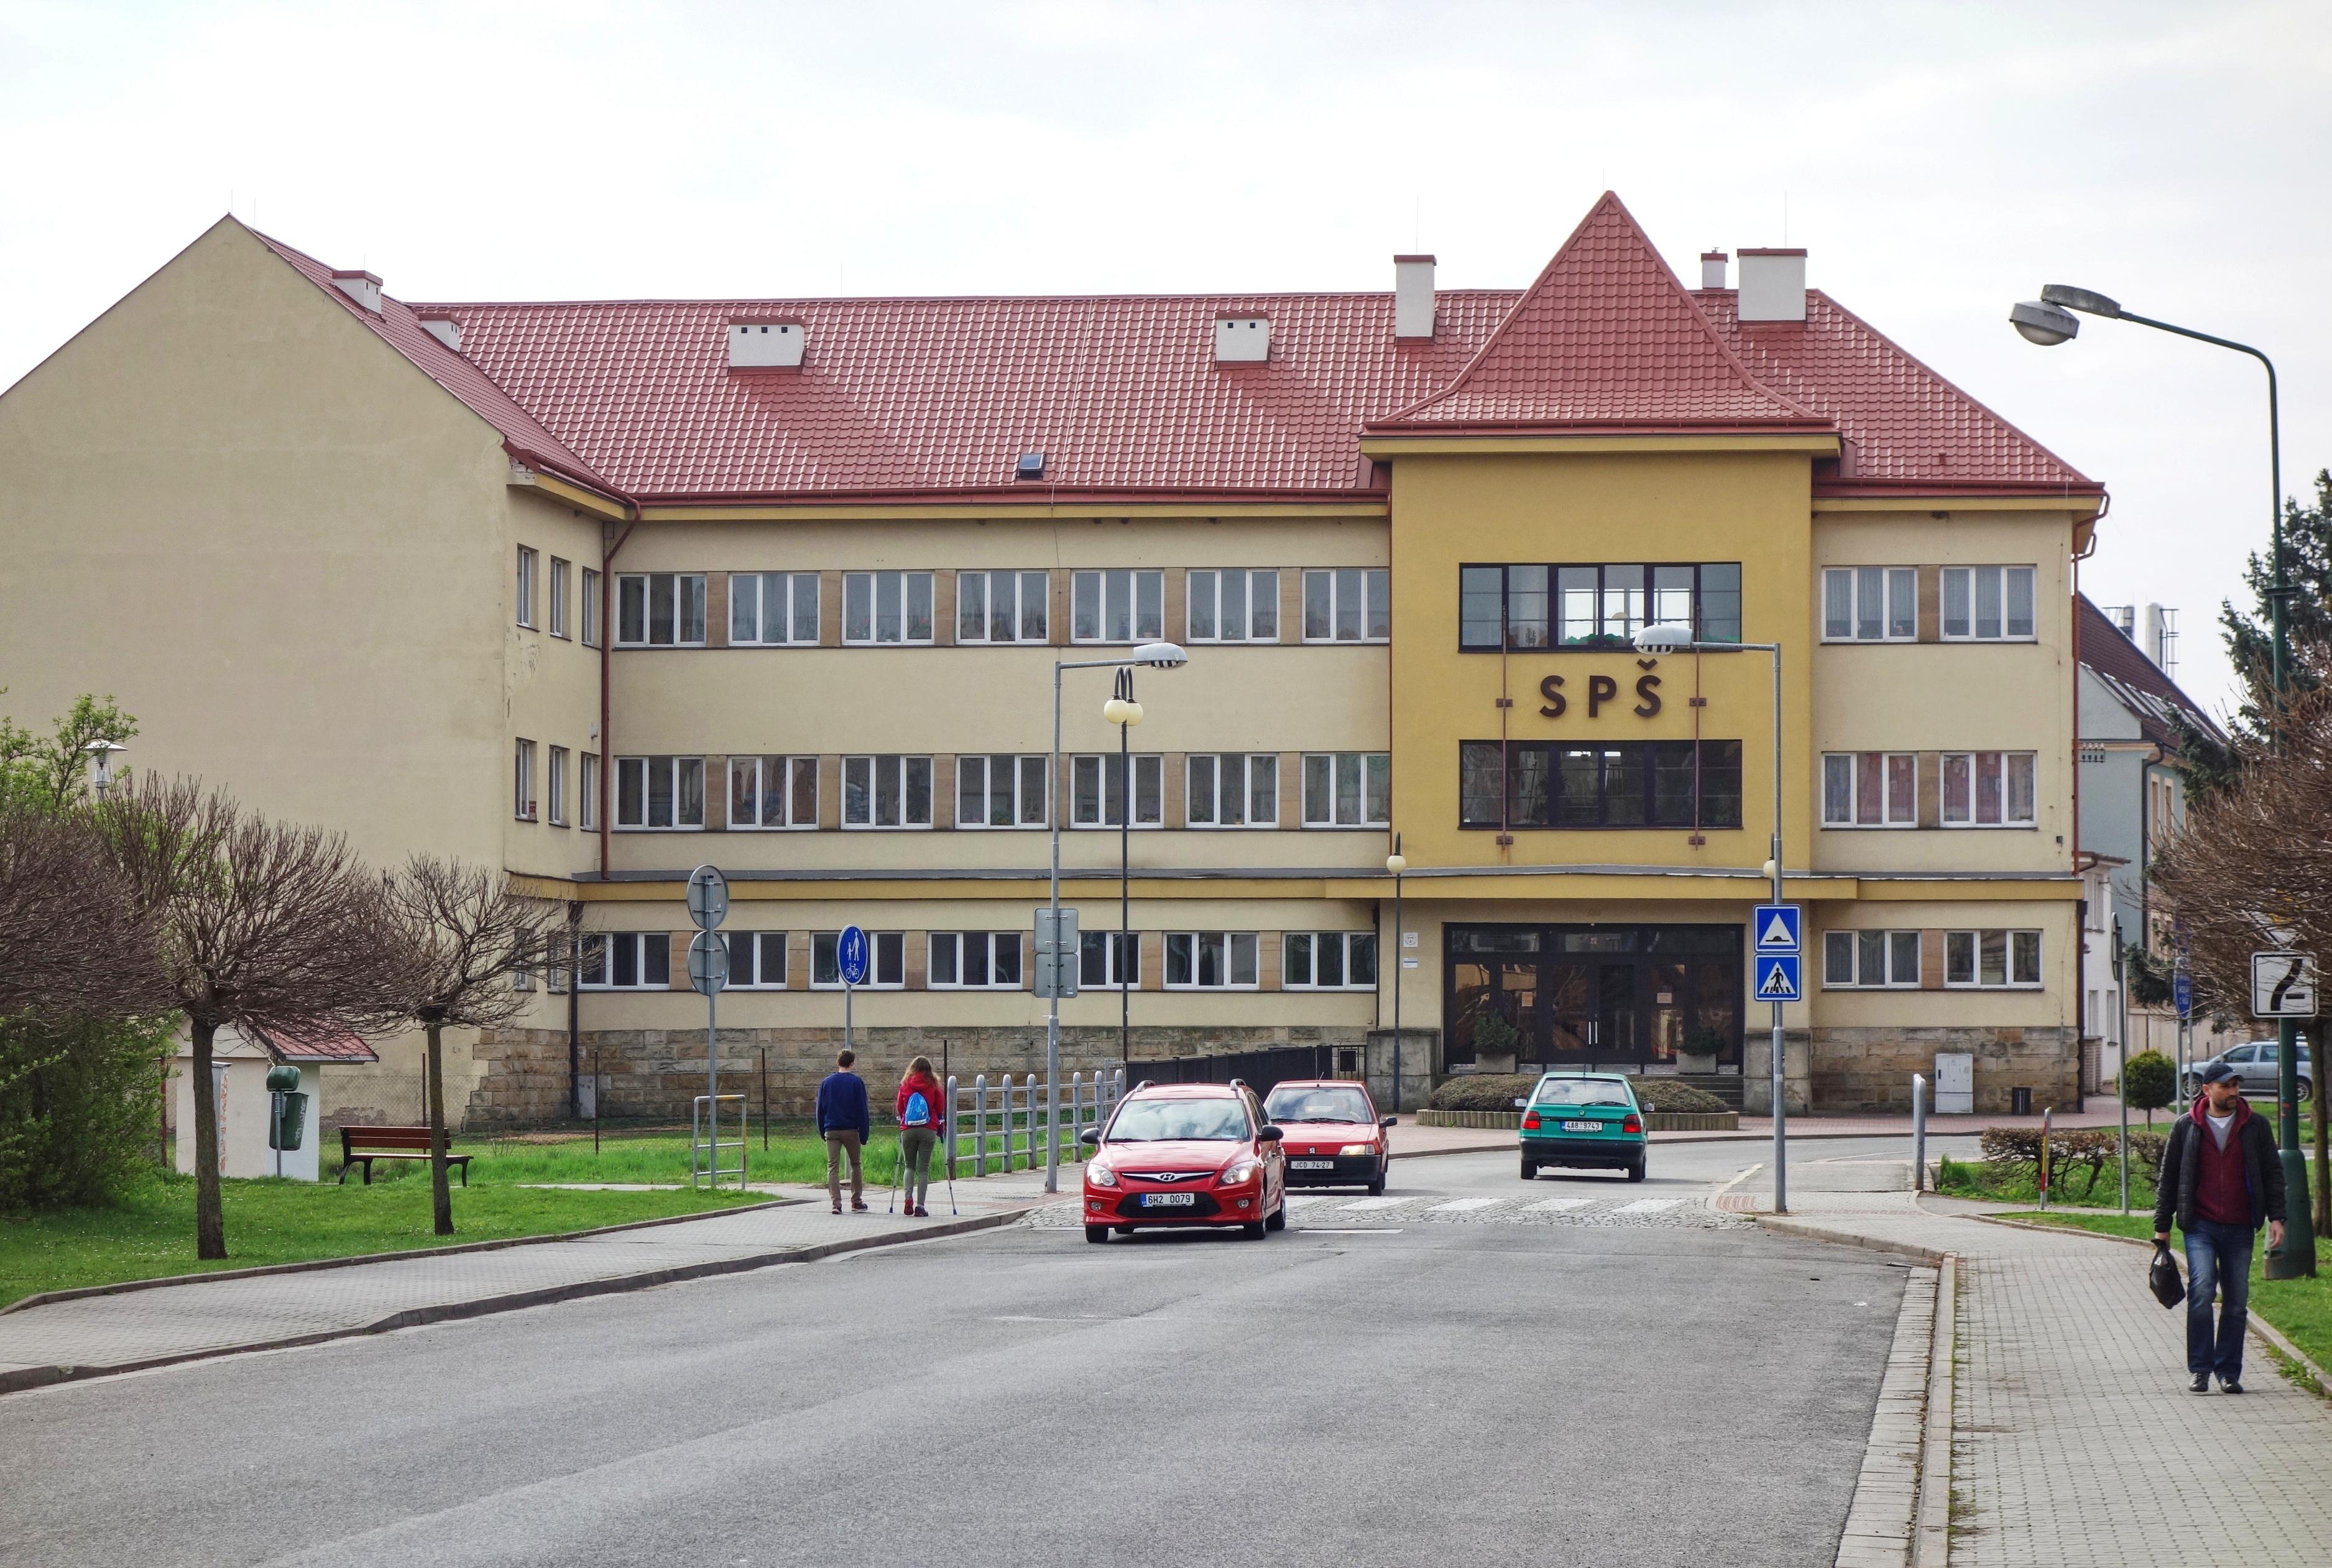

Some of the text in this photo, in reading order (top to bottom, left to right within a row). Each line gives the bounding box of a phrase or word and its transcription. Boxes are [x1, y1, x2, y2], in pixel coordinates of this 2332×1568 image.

[1539, 658, 1662, 717] SPŠ
[1148, 1195, 1163, 1204] 6H2
[1169, 1194, 1191, 1203] 0079
